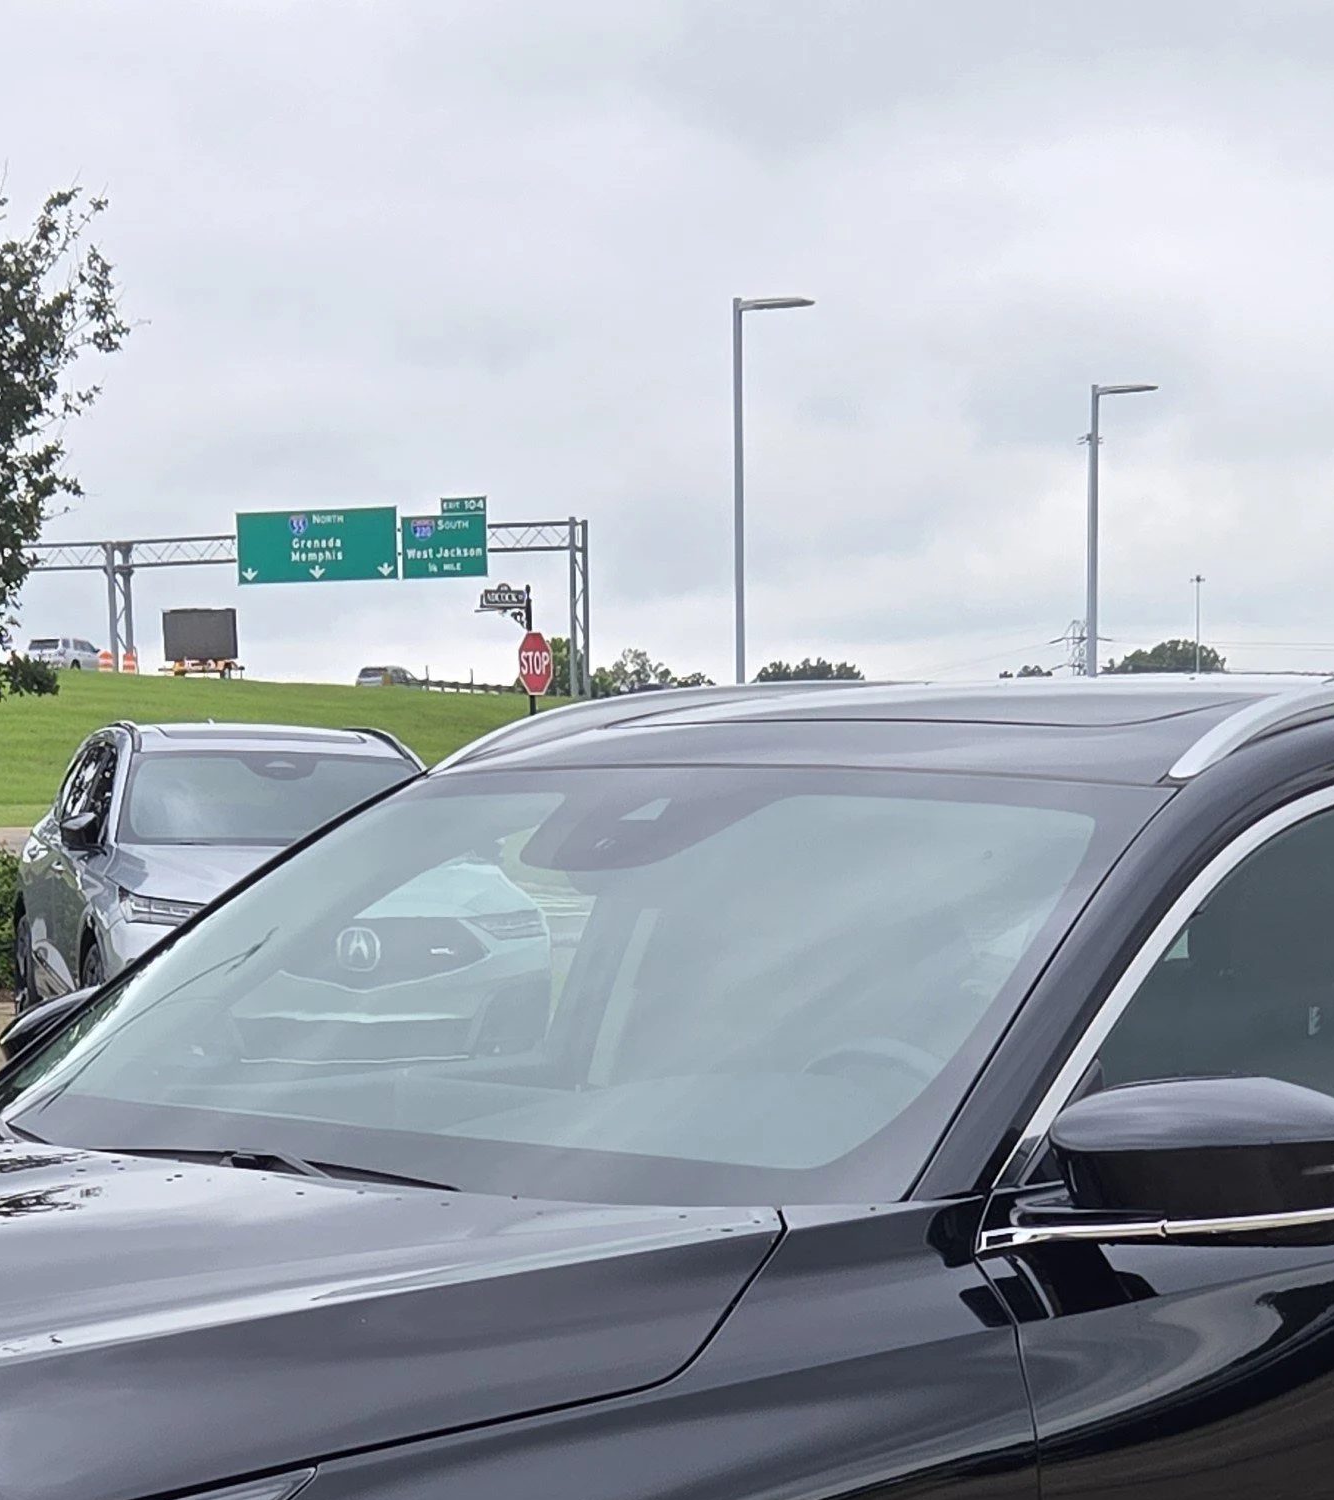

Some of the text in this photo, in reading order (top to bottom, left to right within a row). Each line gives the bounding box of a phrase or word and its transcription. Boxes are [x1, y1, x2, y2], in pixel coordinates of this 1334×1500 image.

[443, 499, 484, 510] EXIT 104
[293, 514, 344, 534] 55 NORTH
[437, 519, 469, 530] SOUTH
[292, 537, 342, 548] Grenada
[291, 550, 343, 563] Memphis
[406, 547, 483, 559] West Jackson
[443, 562, 462, 571] MILE
[520, 651, 550, 675] STOP
